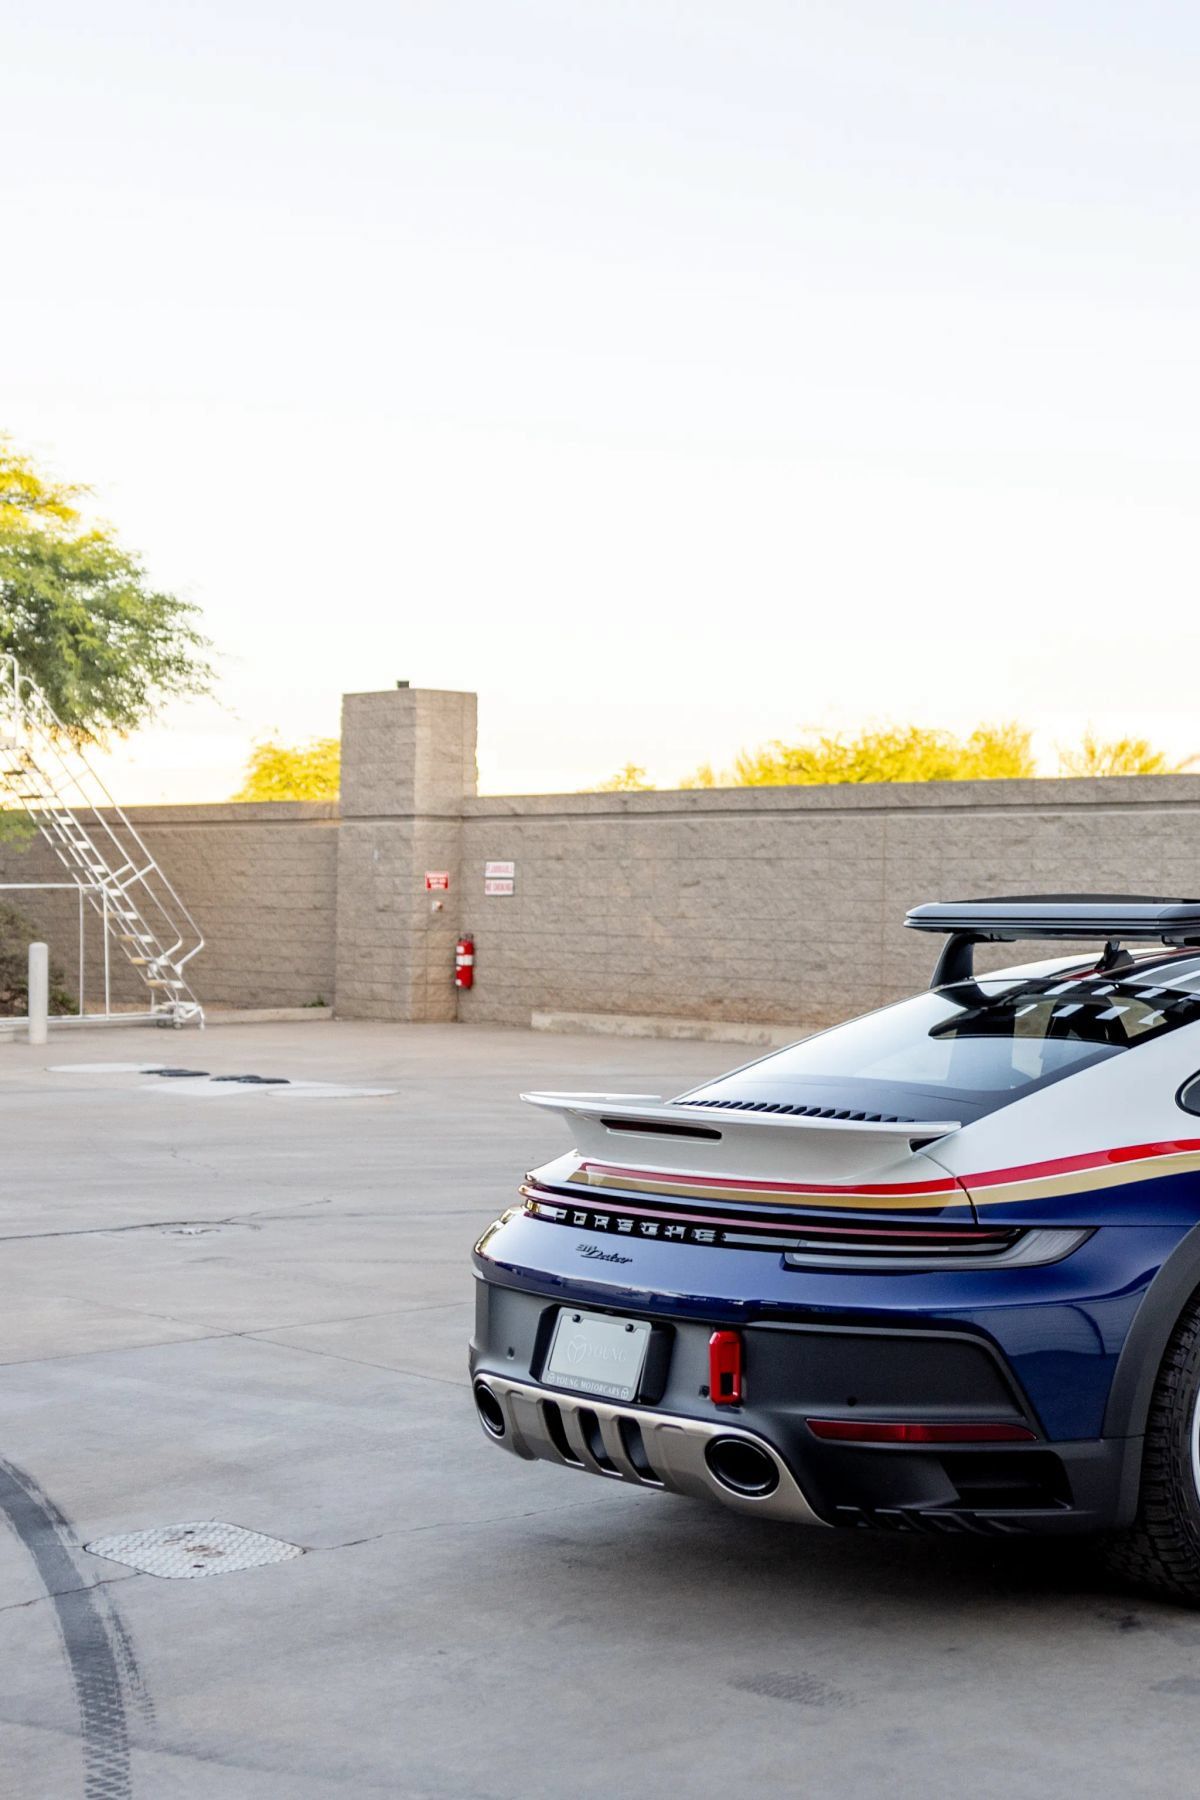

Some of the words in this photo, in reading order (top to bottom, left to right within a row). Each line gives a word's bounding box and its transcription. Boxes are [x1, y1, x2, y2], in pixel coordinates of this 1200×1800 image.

[554, 1208, 716, 1243] PORSCHE
[587, 1342, 627, 1362] YOUNG
[556, 1376, 579, 1388] YOUNG
[580, 1380, 620, 1397] MOTORCARS
